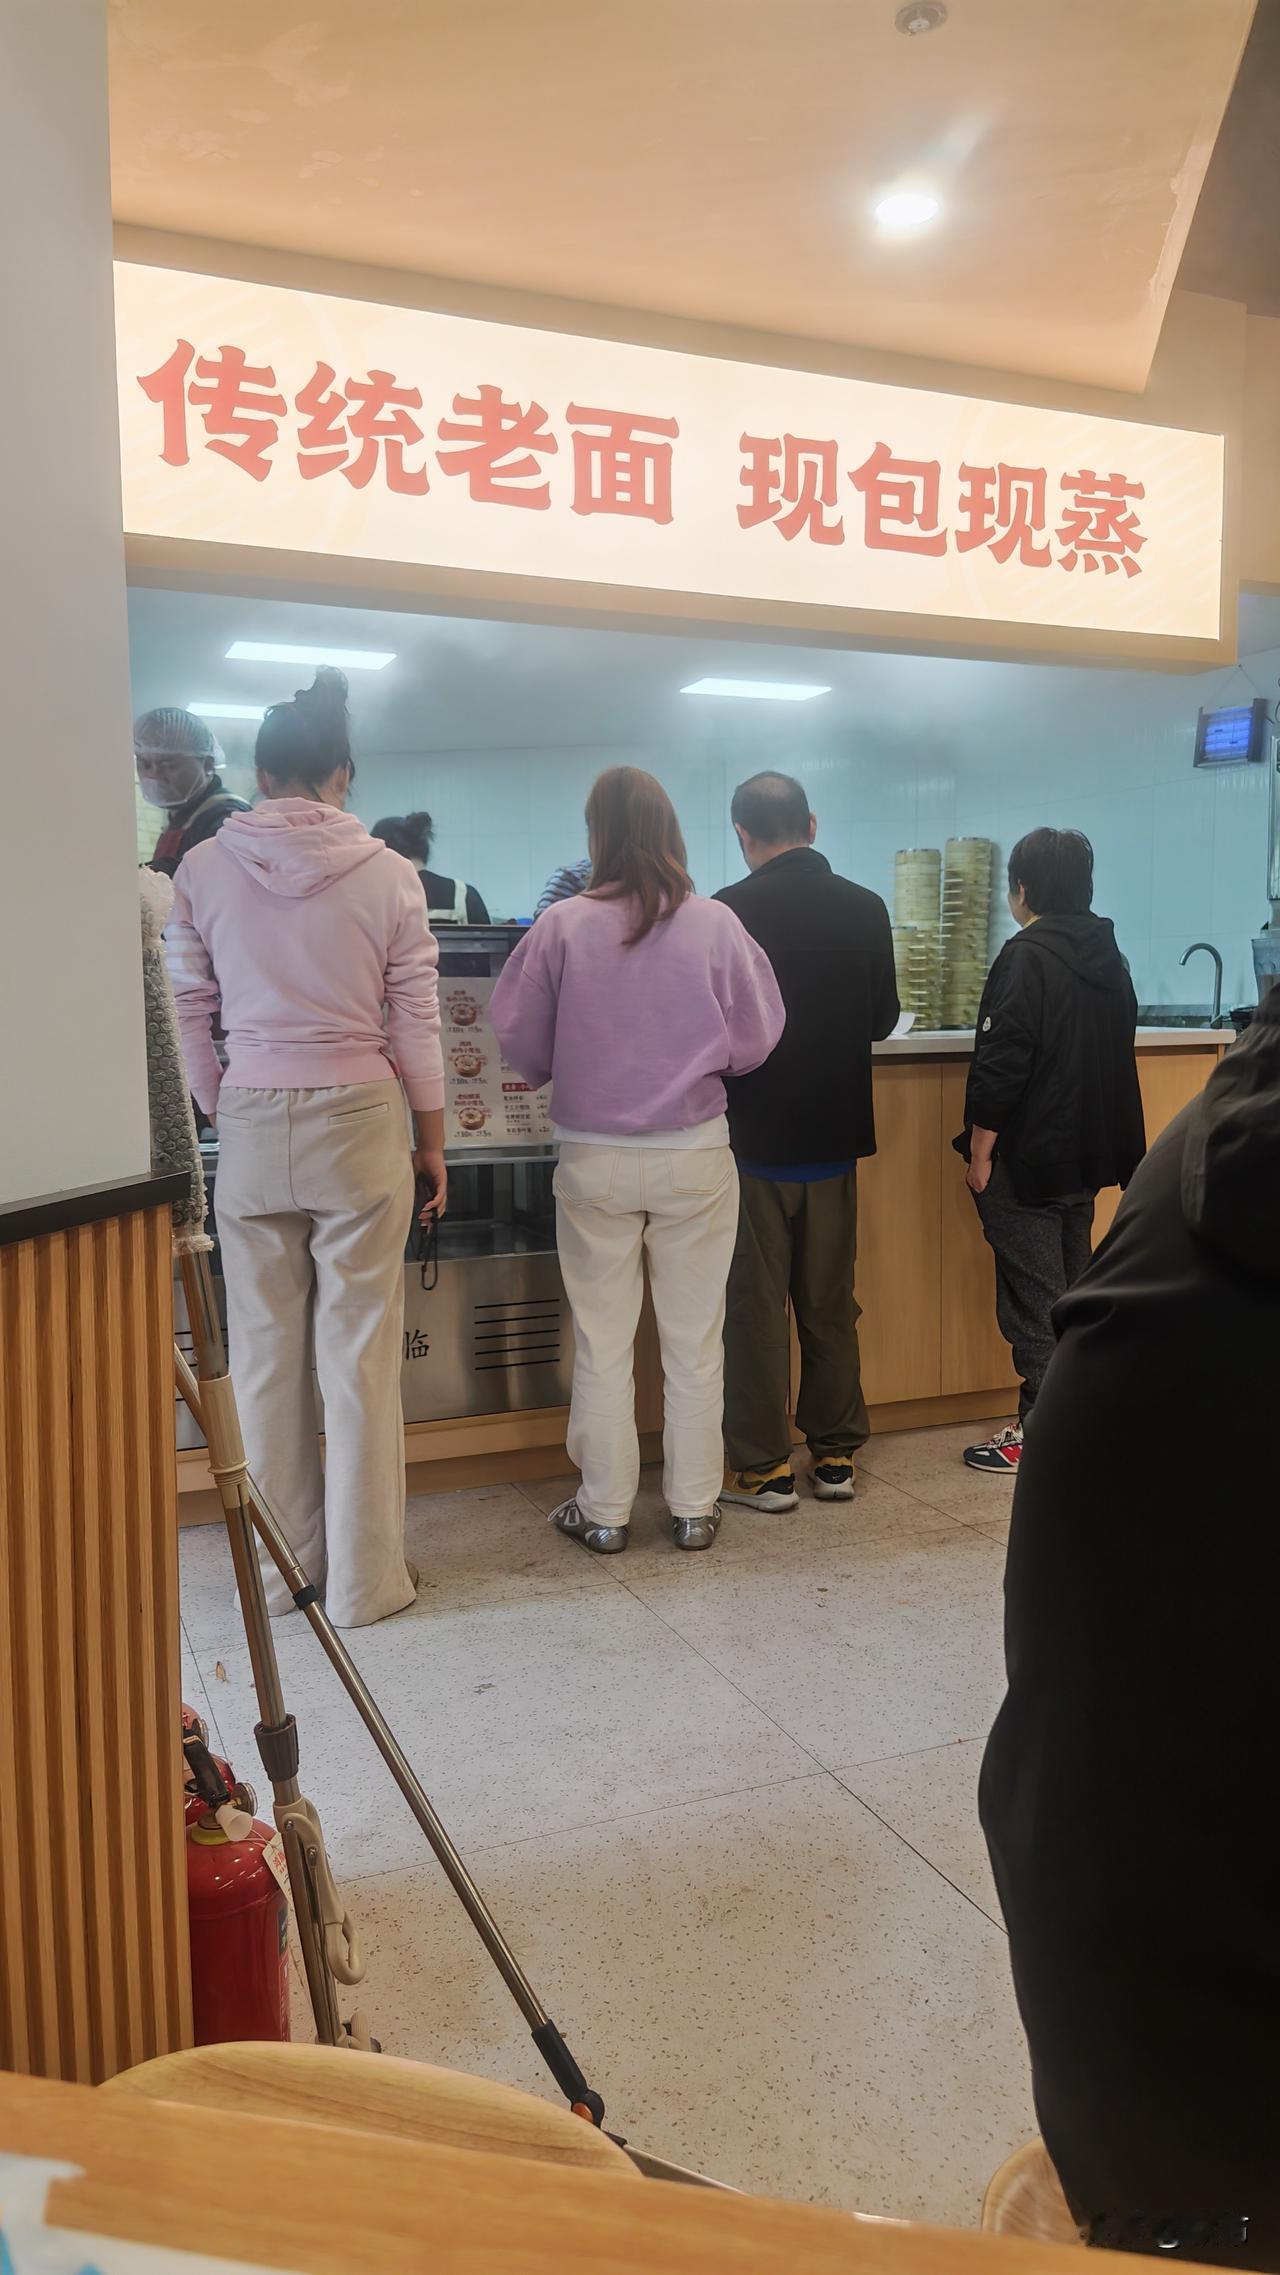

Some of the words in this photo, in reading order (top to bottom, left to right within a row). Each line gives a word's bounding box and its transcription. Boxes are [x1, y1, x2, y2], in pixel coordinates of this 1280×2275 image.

[136, 338, 680, 525] 传统老面
[736, 431, 1149, 579] 现包现蒸
[405, 1329, 430, 1360] 临
